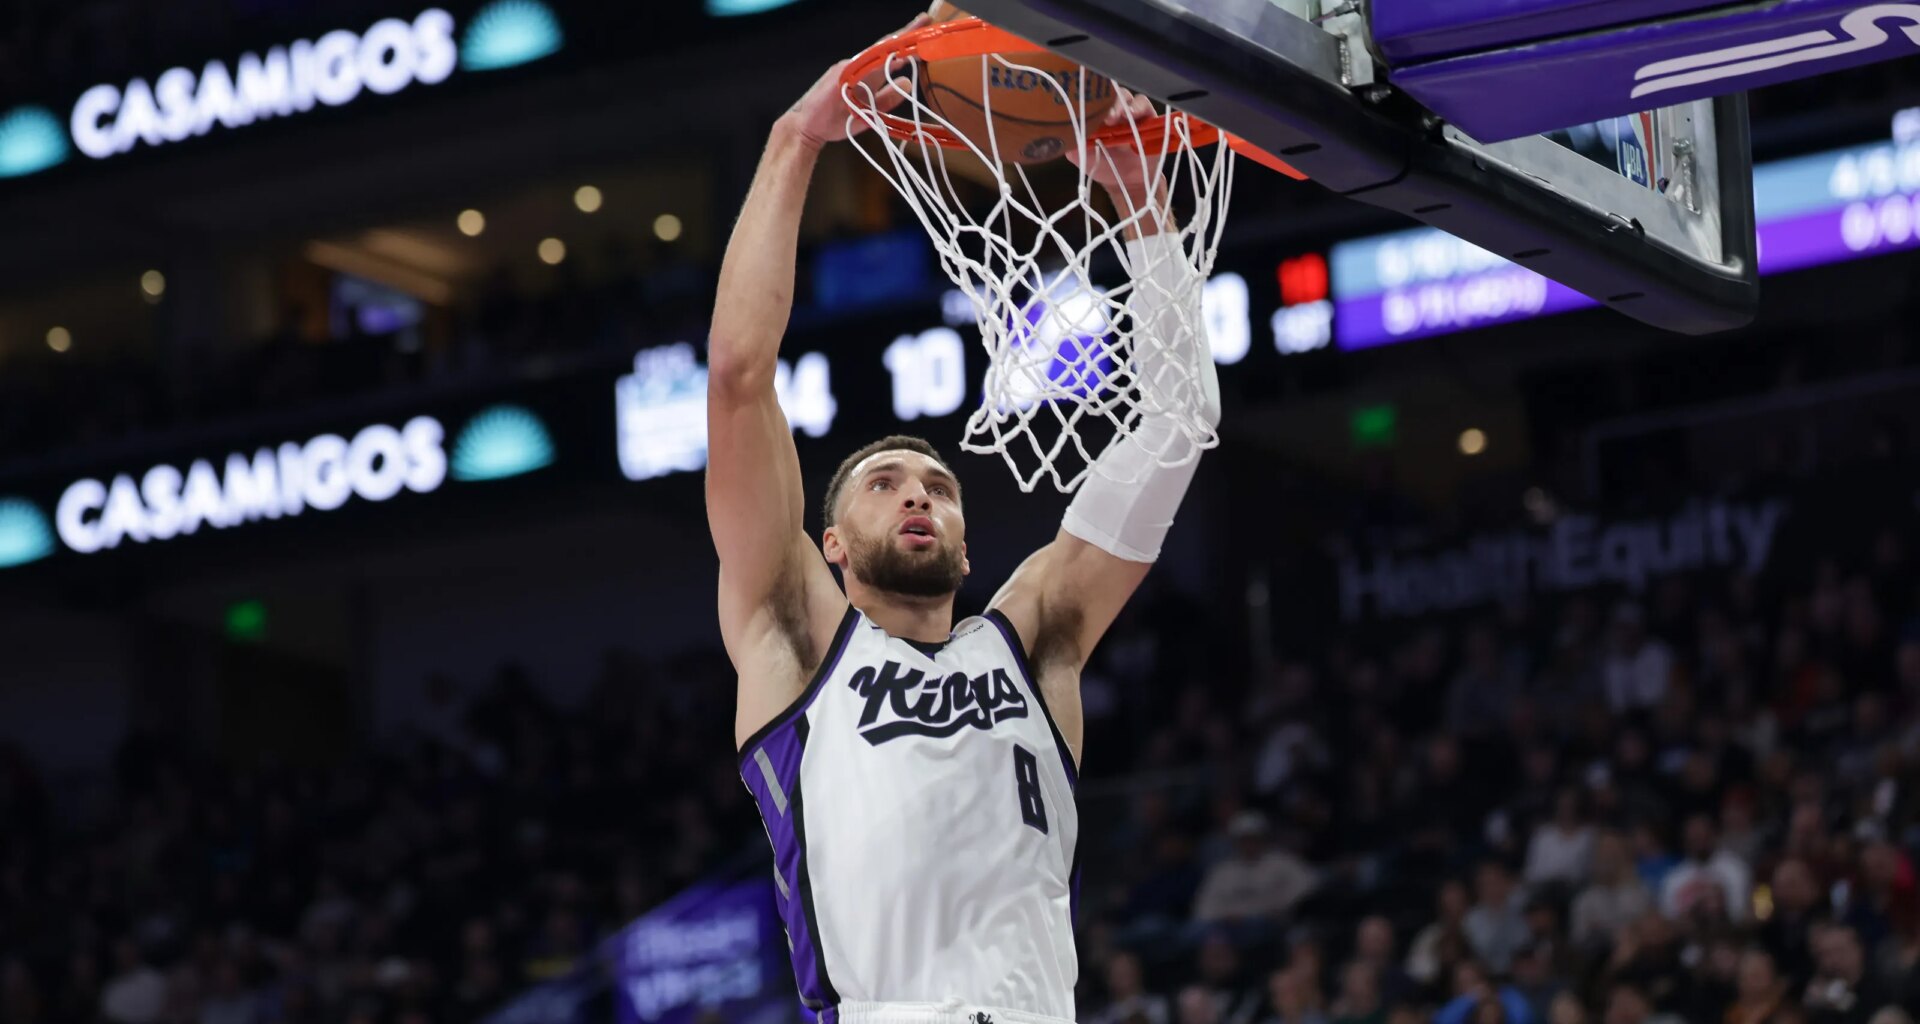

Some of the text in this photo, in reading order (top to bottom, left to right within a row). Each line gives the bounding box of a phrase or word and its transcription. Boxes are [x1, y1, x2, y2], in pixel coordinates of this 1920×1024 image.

[70, 8, 457, 158] CASAMIGOS
[1622, 140, 1645, 180] NBA
[882, 326, 967, 421] 10
[56, 415, 447, 553] CASAMIGOS
[848, 659, 1029, 747] Kings
[1013, 743, 1049, 835] 8
